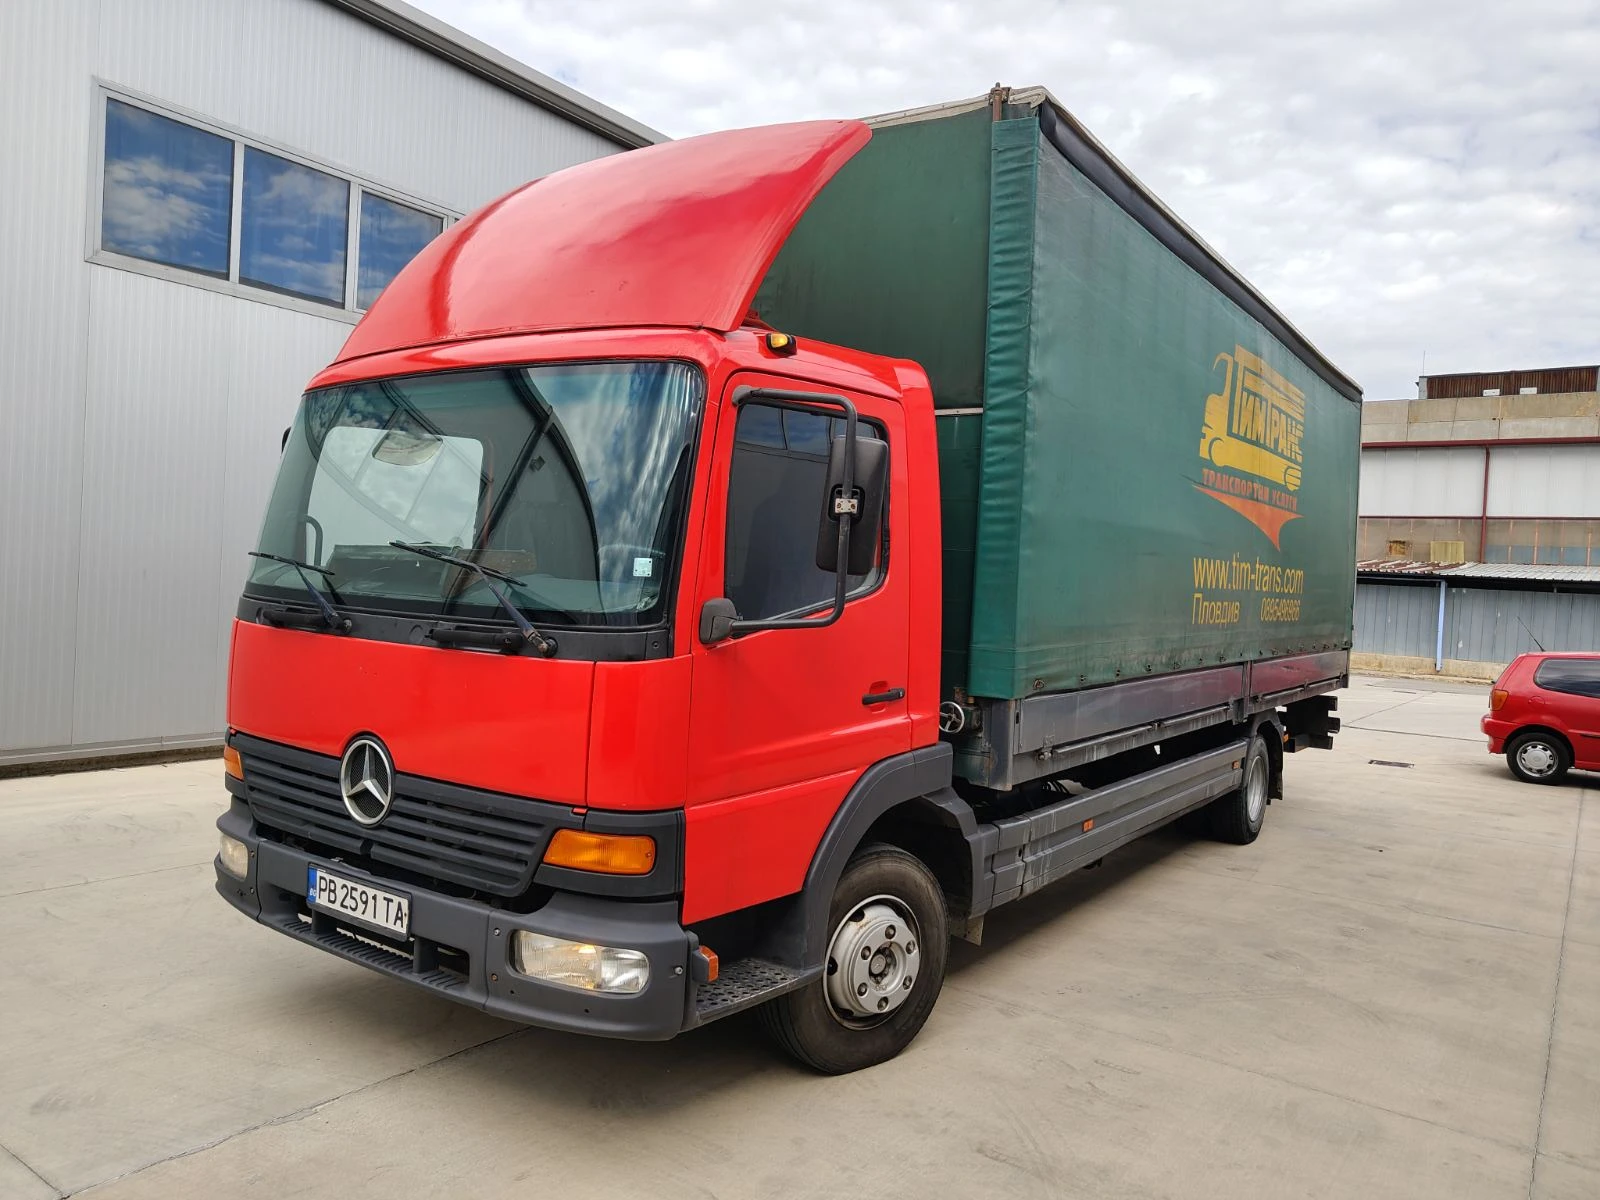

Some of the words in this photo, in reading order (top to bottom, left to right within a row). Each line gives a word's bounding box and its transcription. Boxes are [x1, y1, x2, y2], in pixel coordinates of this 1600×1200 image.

[1202, 467, 1269, 502] ТРАНСПОРТНИ
[1271, 488, 1298, 512] УСЛУГИ
[1193, 552, 1304, 594] www.tim-trans.com
[1192, 592, 1240, 628] Пловдив
[319, 875, 337, 905] PB
[340, 883, 378, 920] 2591
[383, 896, 404, 929] TA
